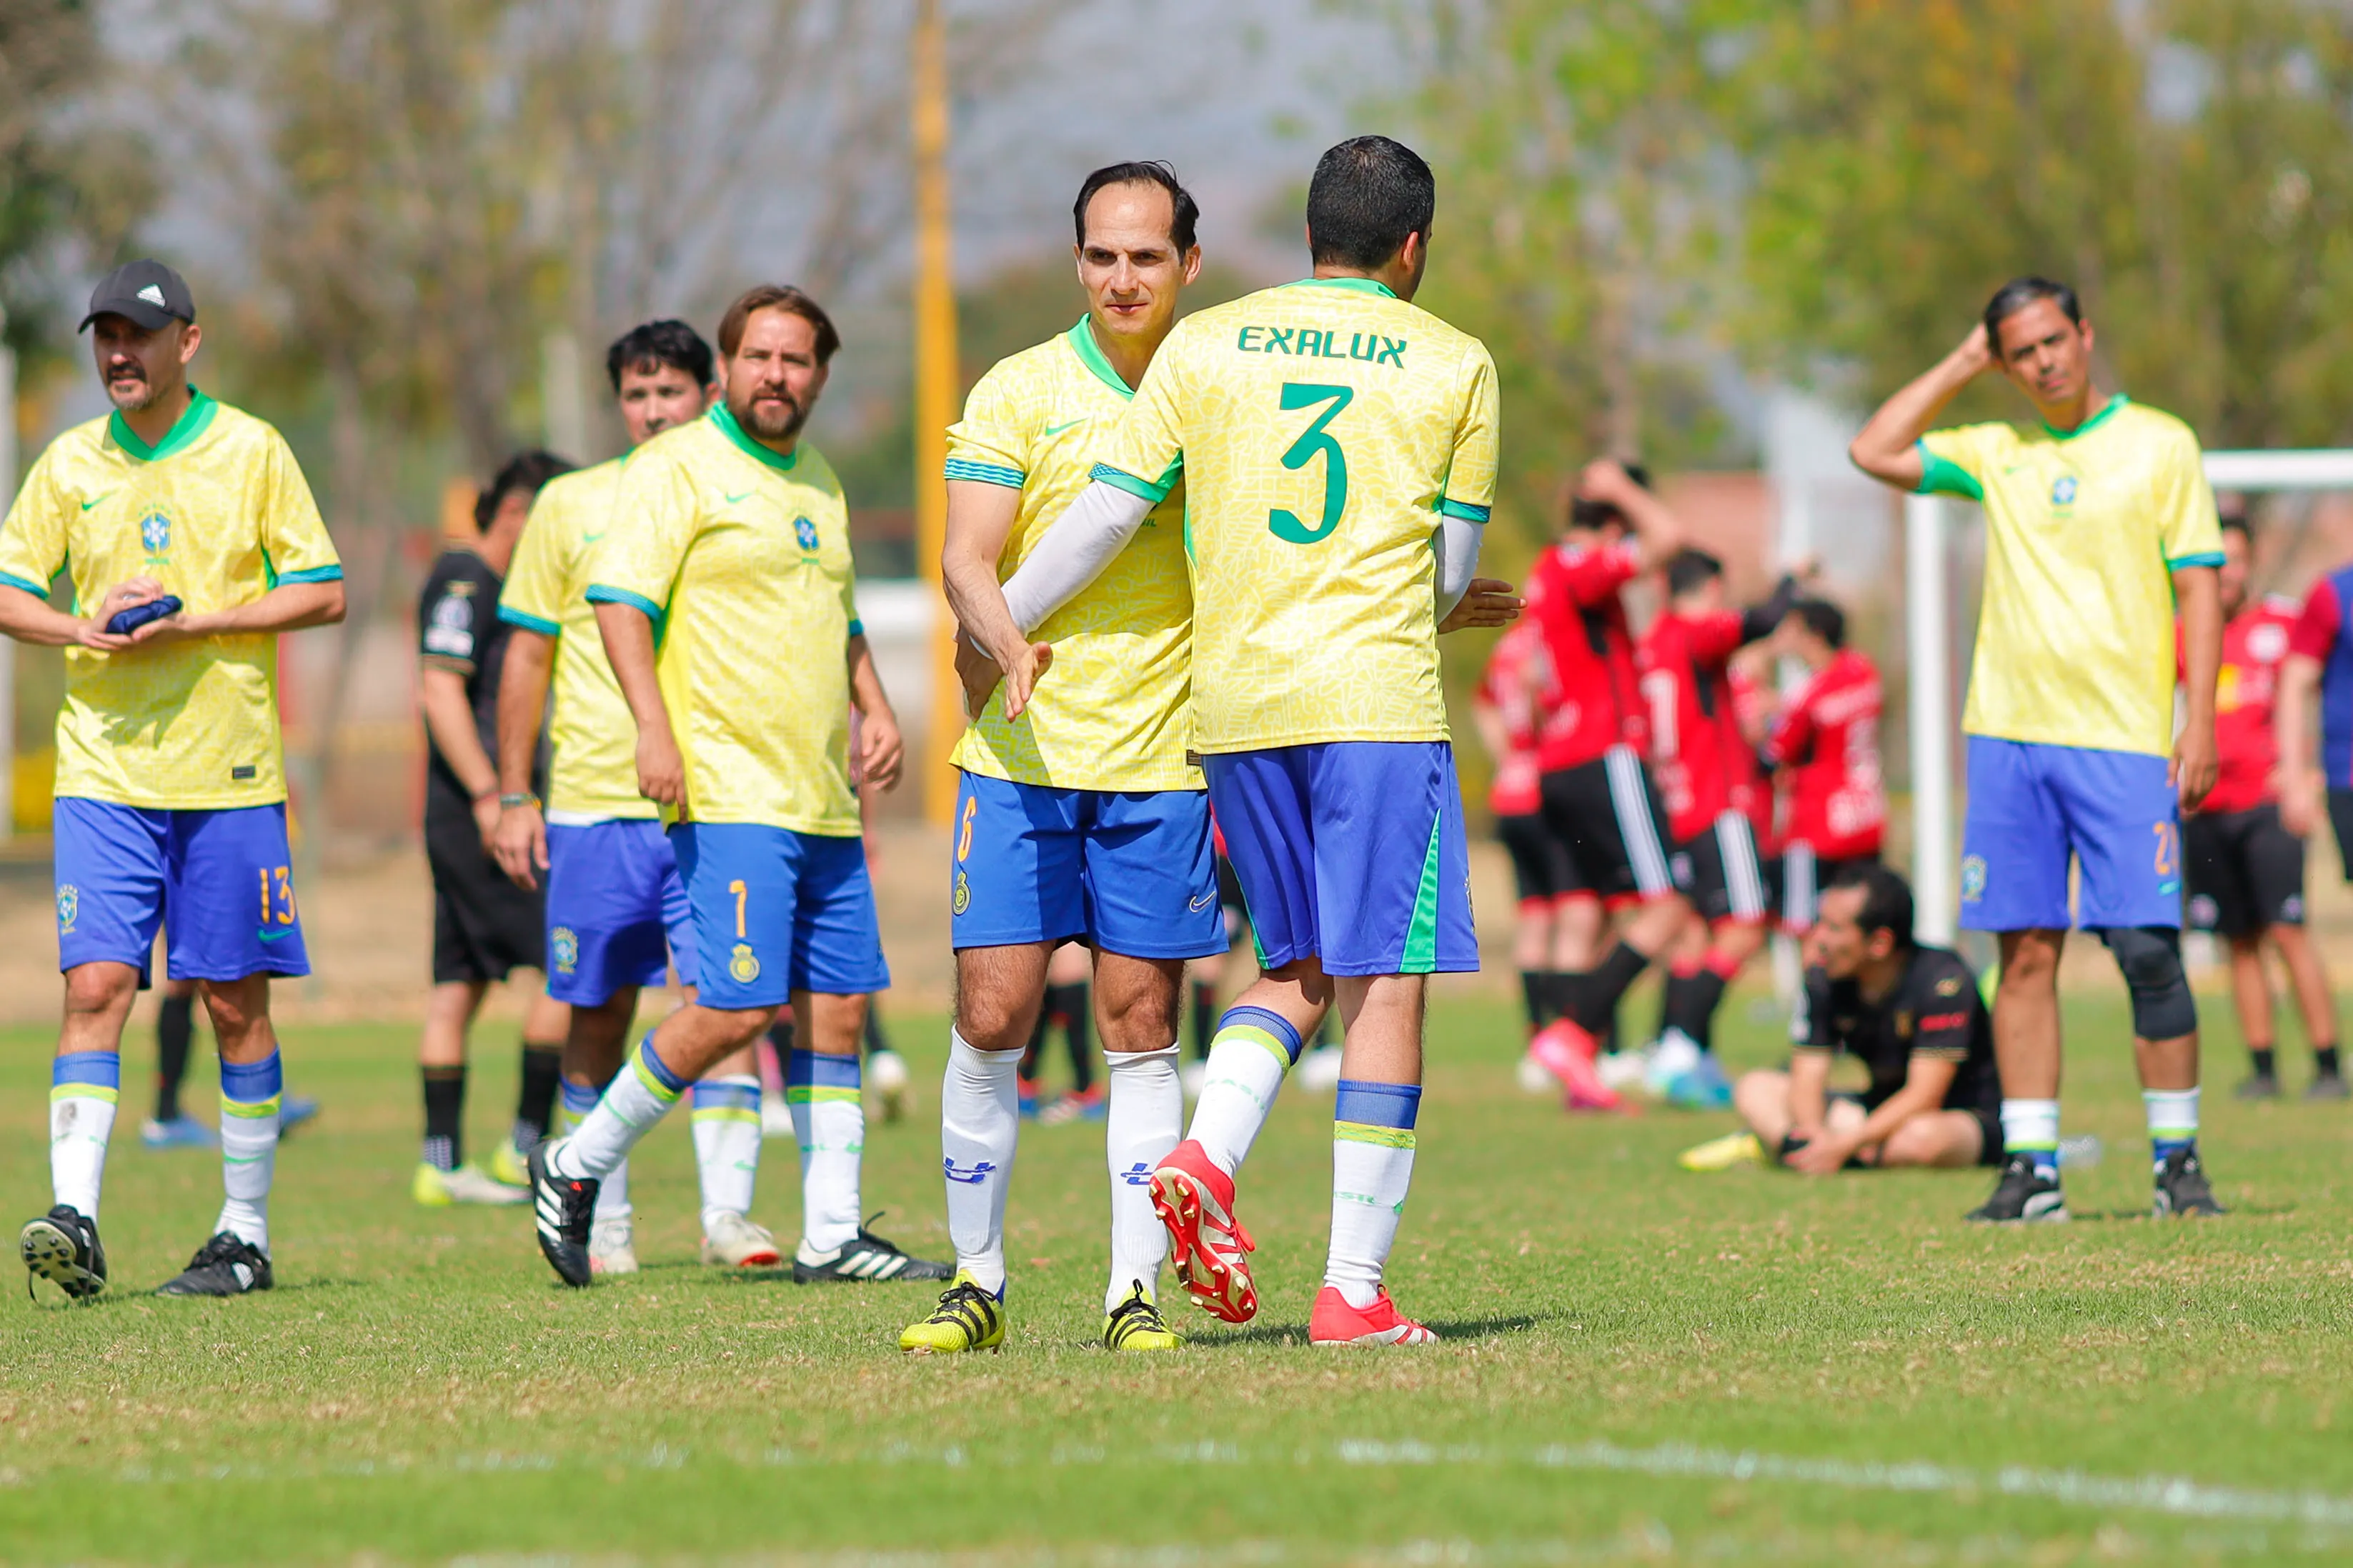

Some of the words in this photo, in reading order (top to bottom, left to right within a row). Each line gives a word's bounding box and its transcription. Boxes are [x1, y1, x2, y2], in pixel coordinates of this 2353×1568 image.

[1238, 326, 1407, 369] EXALUX
[1268, 382, 1354, 544] 3
[957, 796, 977, 862] 6
[260, 866, 296, 924] 13
